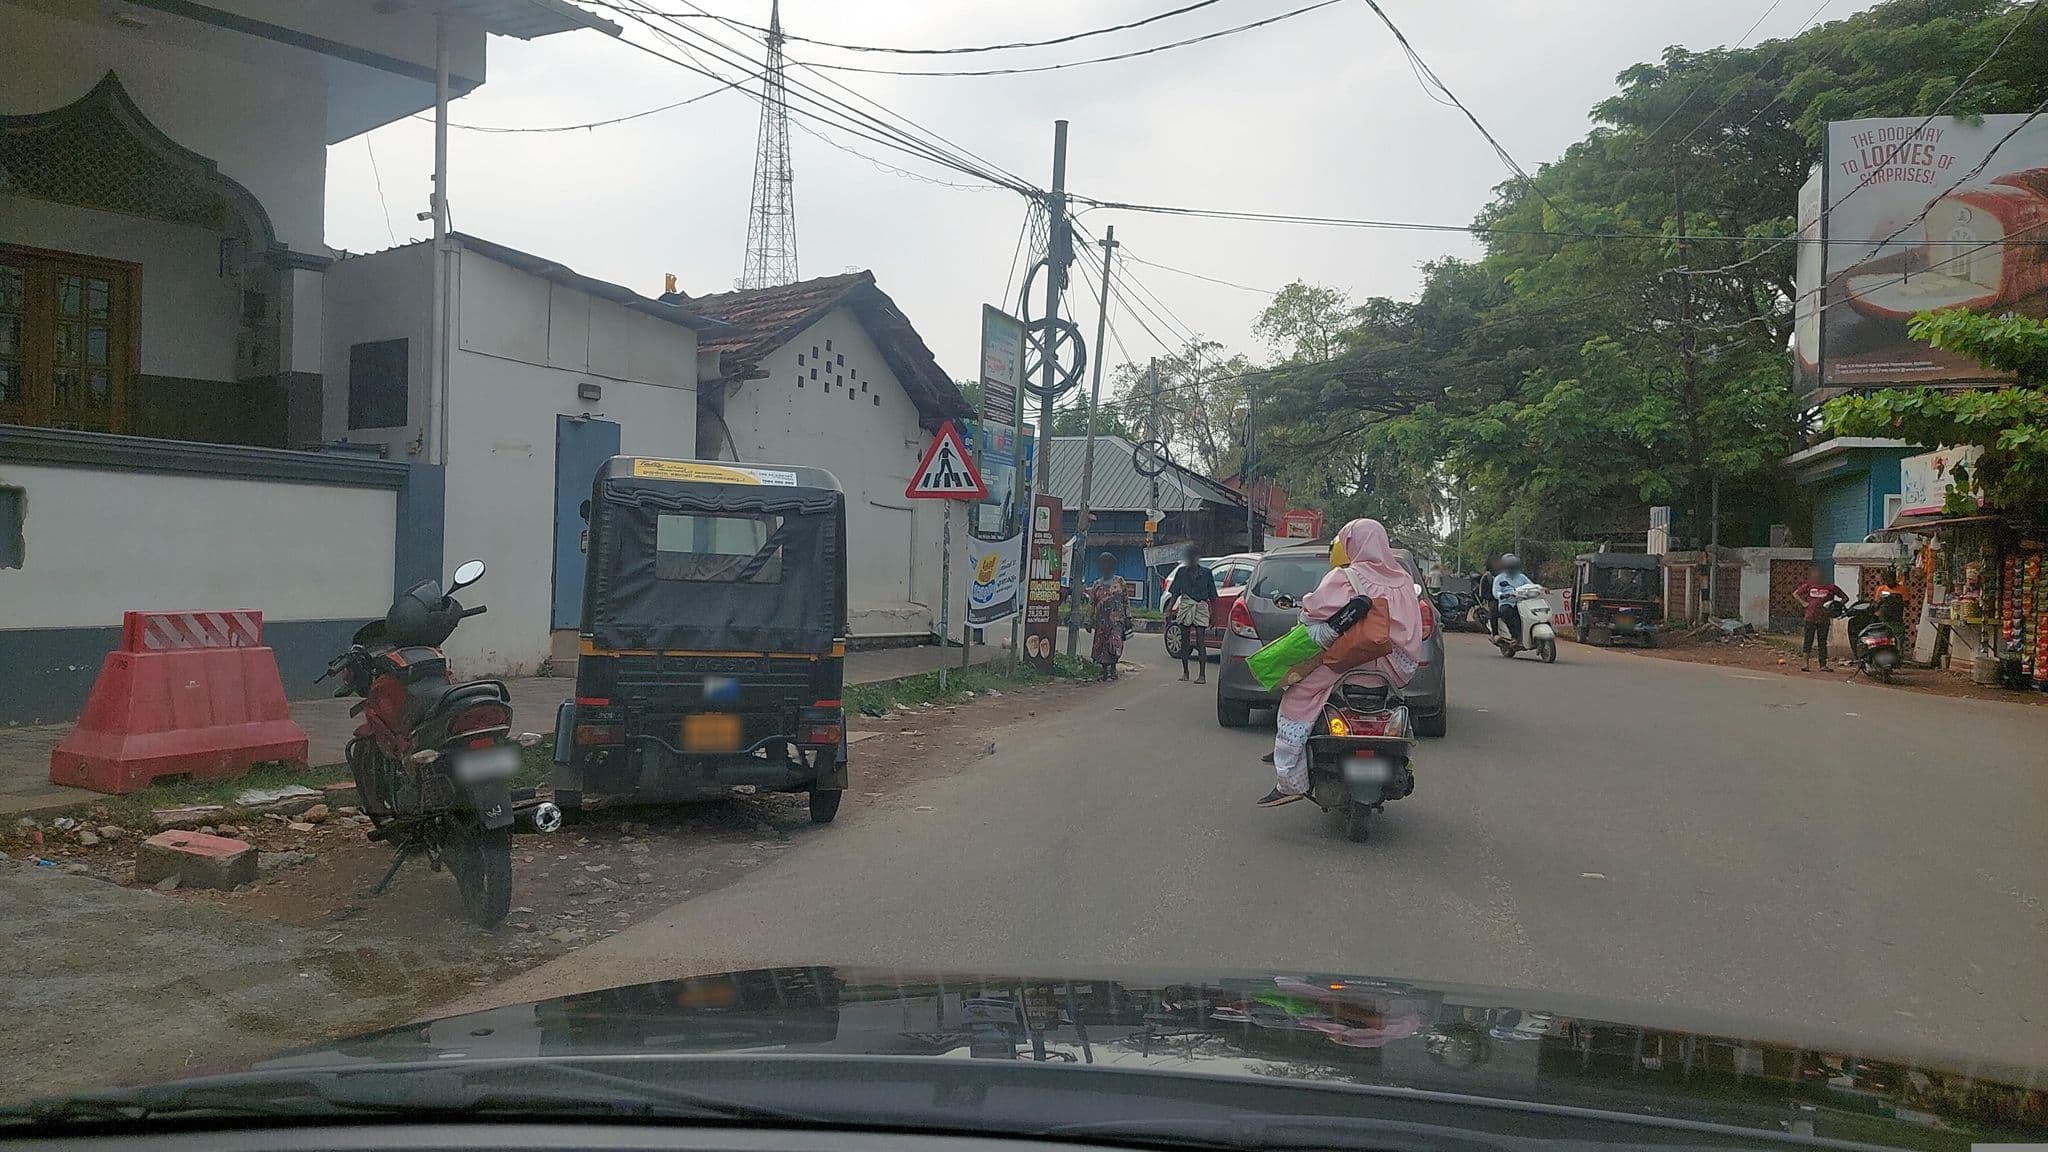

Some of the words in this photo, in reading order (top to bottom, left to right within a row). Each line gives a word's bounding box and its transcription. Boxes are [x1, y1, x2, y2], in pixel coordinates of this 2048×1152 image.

[1851, 130, 1875, 149] THE
[1878, 126, 1944, 143] DOORWAY
[1840, 159, 1858, 176] TO
[1860, 143, 1936, 170] LOAVES
[1937, 154, 1956, 170] OF
[1859, 167, 1936, 187] SURPRISES!
[1031, 559, 1053, 579] INL
